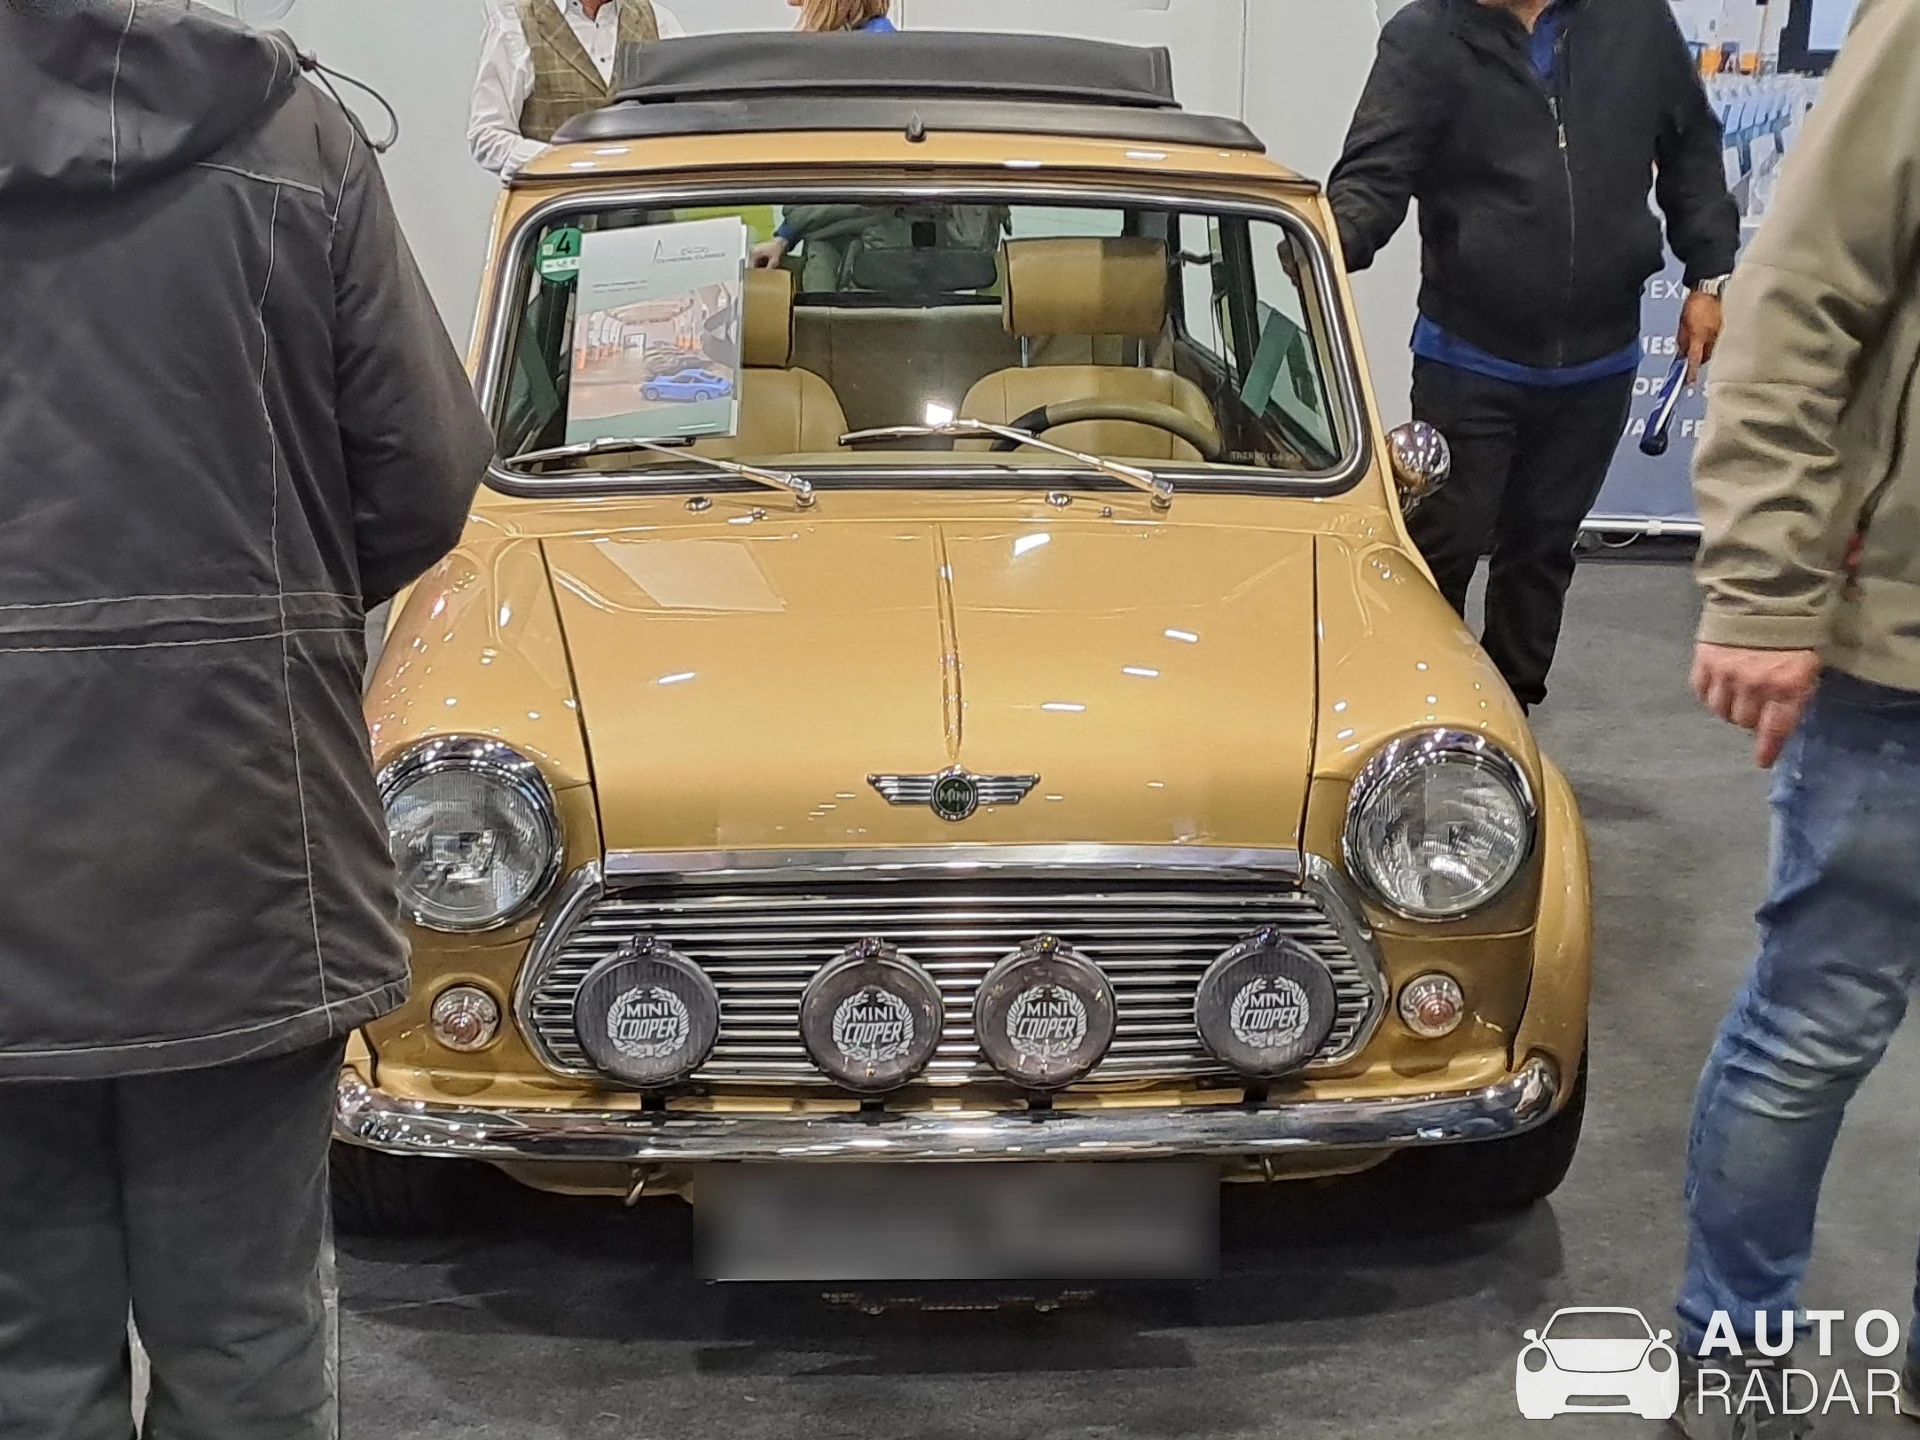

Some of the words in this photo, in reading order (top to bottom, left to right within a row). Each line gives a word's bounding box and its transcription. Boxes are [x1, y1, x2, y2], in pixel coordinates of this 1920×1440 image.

[556, 231, 572, 254] 4
[626, 1002, 670, 1018] MINI
[1026, 1002, 1069, 1018] MINI
[1250, 991, 1291, 1008] MINI
[852, 1006, 894, 1022] MINI
[1241, 1006, 1300, 1031] COOPER
[618, 1017, 679, 1041] COOPER
[844, 1021, 903, 1044] COOPER
[1018, 1016, 1076, 1040] COOPER
